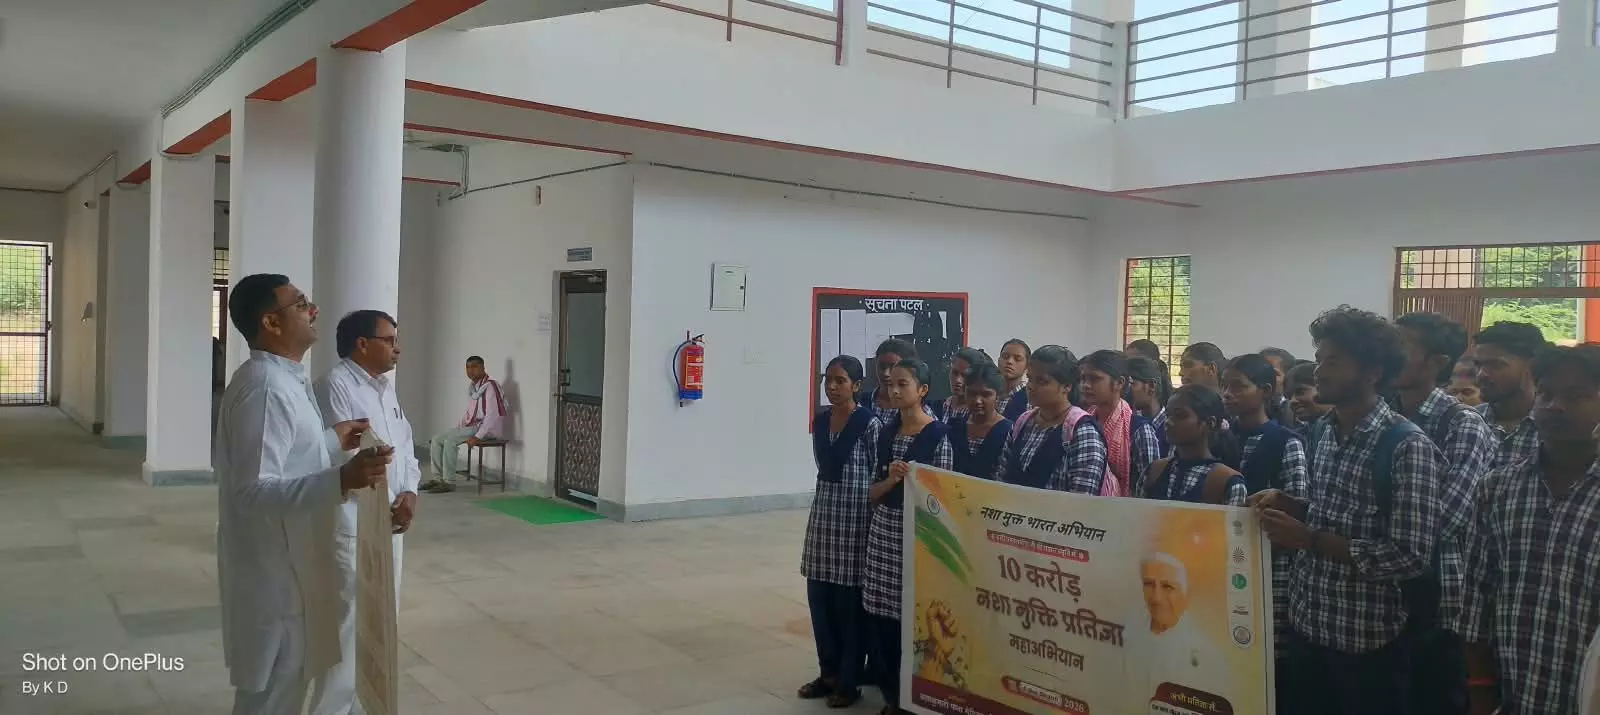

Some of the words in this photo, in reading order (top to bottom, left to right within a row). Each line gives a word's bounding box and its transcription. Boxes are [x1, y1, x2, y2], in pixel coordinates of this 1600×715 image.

[865, 298, 897, 313] सूचना
[899, 299, 924, 311] पटल
[980, 506, 1002, 521] नशा
[1002, 511, 1026, 527] मुक्त
[1027, 515, 1057, 532] भारत
[1057, 521, 1107, 542] अभियान
[998, 554, 1021, 582] 10
[1024, 561, 1082, 603] करोड़
[975, 586, 1011, 616] नशा
[1011, 596, 1059, 630] मुक्ति
[1060, 608, 1125, 647] प्रतिज्ञा
[1008, 633, 1085, 671] महाअभियान
